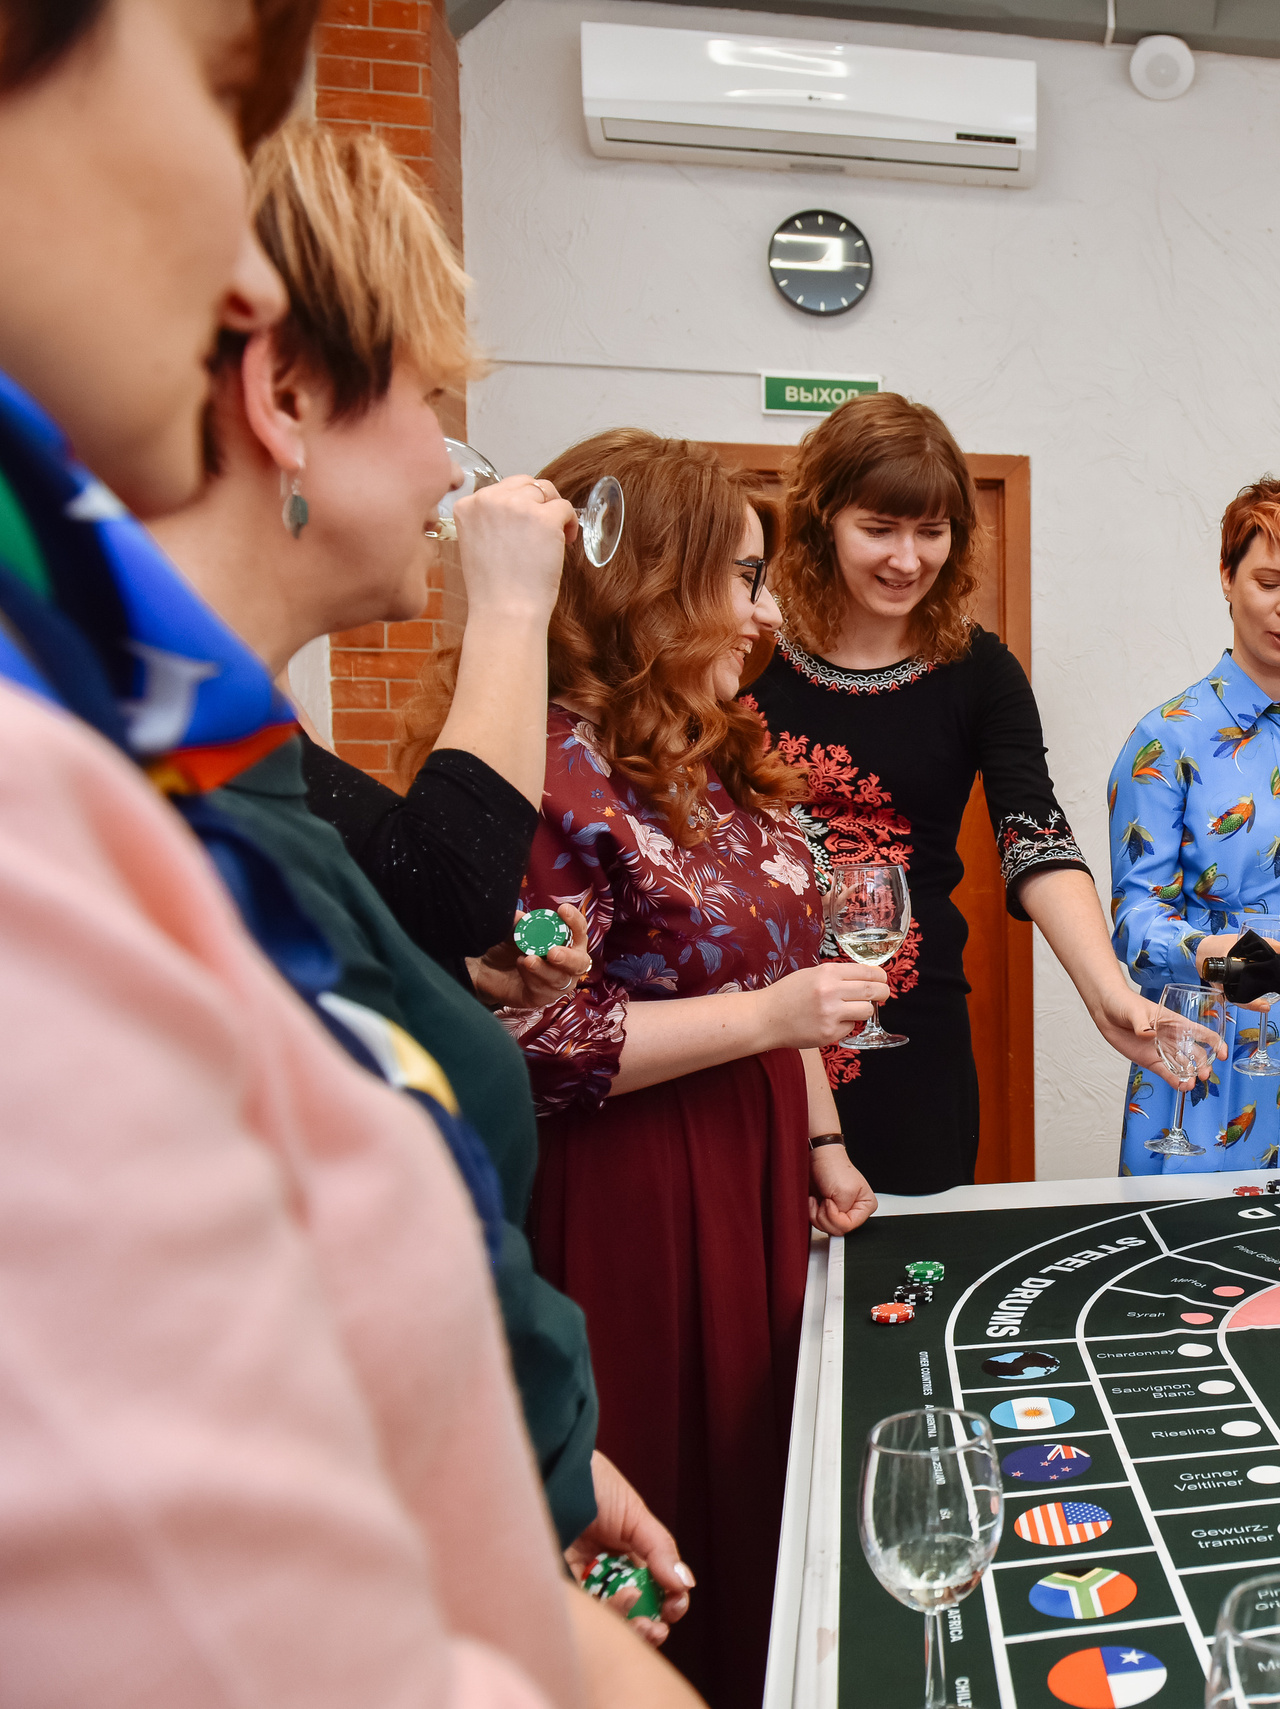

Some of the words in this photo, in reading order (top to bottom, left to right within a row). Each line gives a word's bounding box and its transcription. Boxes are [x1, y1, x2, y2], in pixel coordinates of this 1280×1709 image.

[1040, 1236, 1147, 1274] STEEL
[1170, 1277, 1207, 1289] Merlot
[986, 1277, 1056, 1338] DRUMS
[1126, 1311, 1166, 1319] Syrah
[1096, 1349, 1176, 1359] Chardonnay
[1111, 1382, 1192, 1395] Sauvignon
[1152, 1390, 1196, 1400] Blanc
[1151, 1427, 1217, 1439] Riesling
[1179, 1469, 1239, 1482] Gruner
[1174, 1478, 1244, 1493] Veltliner
[1191, 1524, 1270, 1539] Gewurz-
[1197, 1532, 1275, 1549] traminer
[947, 1609, 964, 1643] AFRICA
